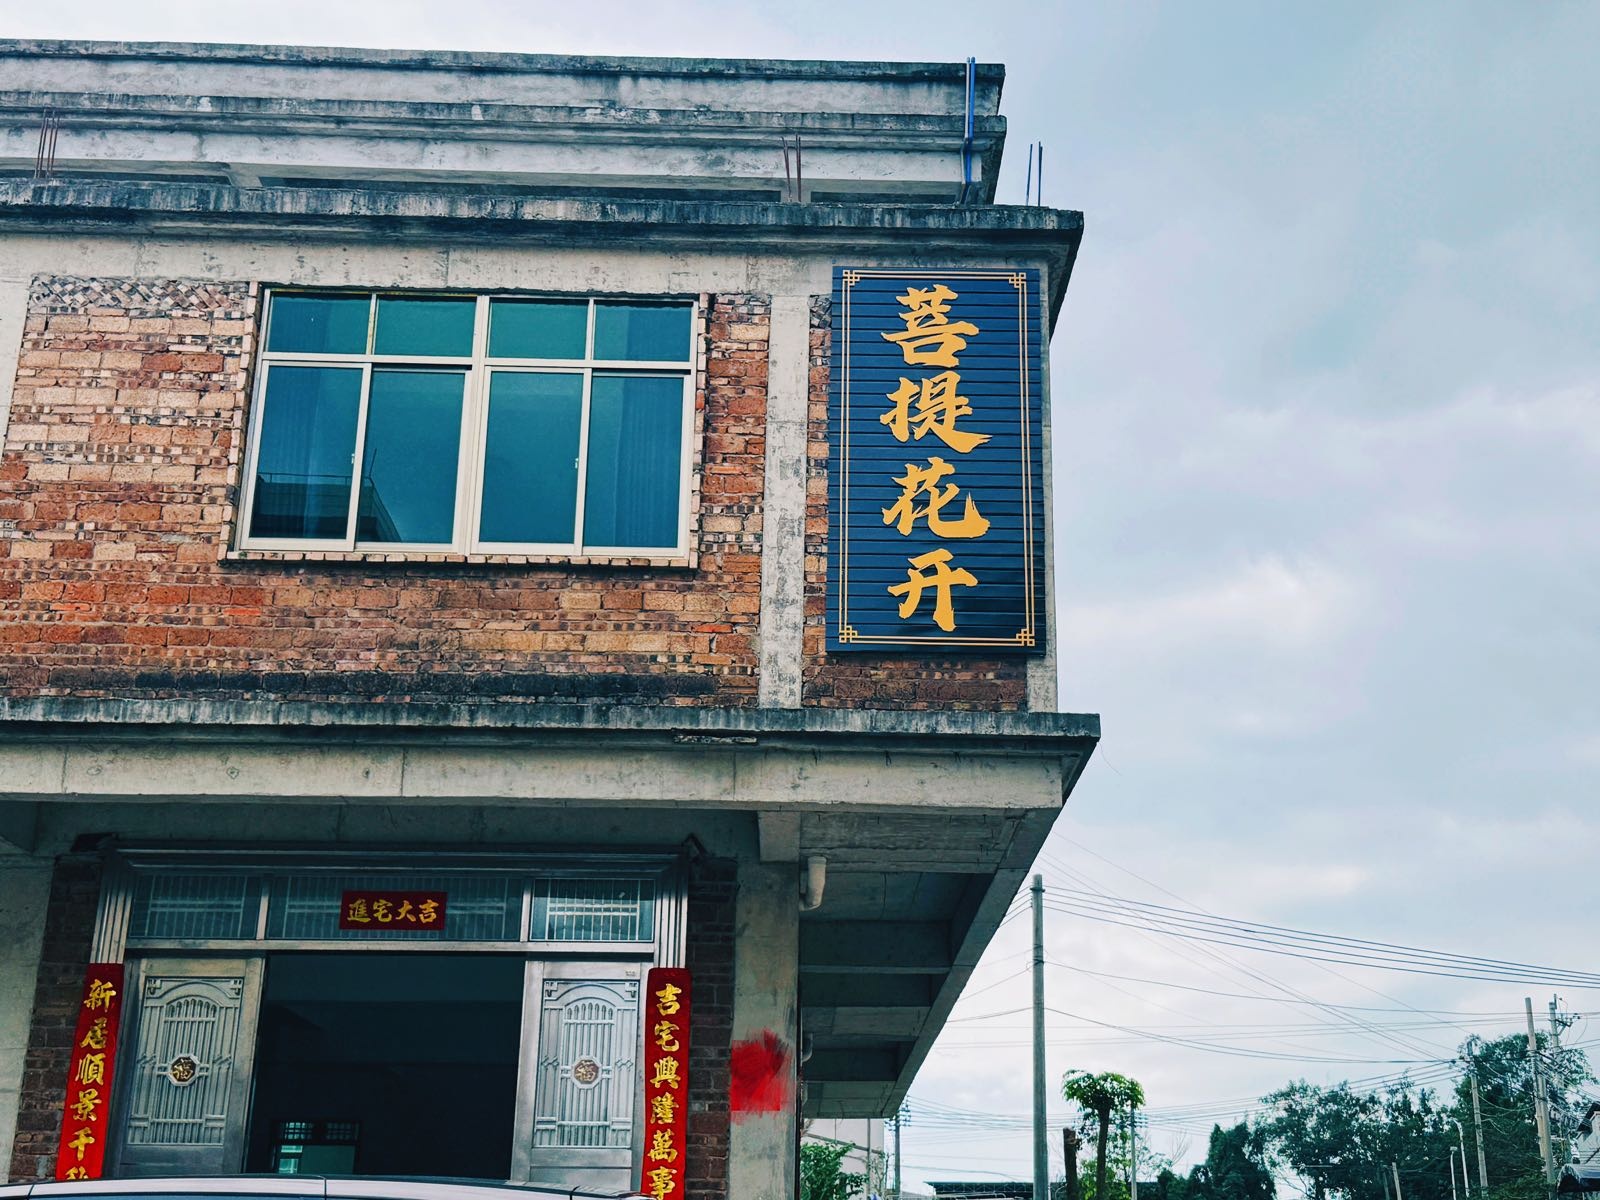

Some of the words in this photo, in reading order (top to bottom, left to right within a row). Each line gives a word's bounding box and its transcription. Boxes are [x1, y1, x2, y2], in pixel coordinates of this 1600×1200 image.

[880, 284, 993, 632] 菩提花开
[347, 899, 439, 923] 進宅大吉
